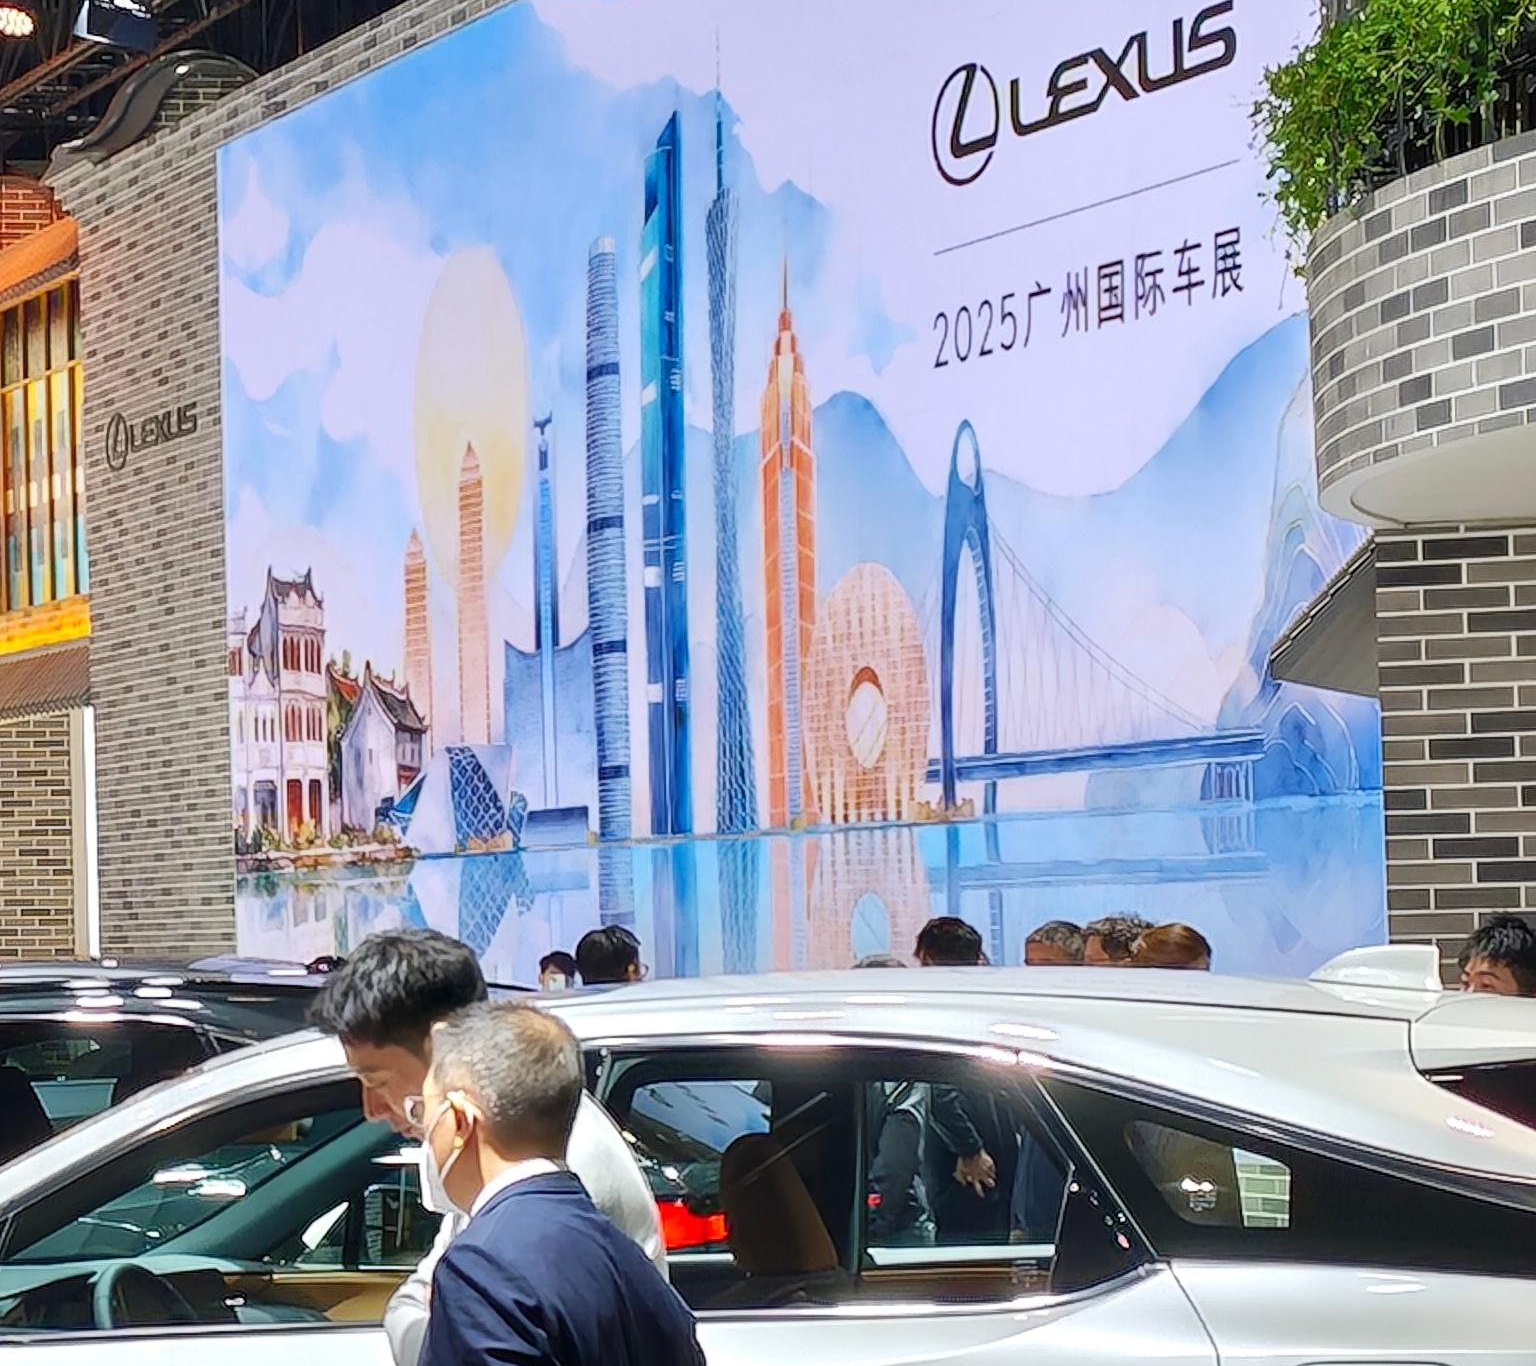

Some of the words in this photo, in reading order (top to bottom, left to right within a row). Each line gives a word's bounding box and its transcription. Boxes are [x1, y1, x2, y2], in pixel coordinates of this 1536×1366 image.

[933, 226, 1244, 369] 2025广州国际车展
[129, 401, 197, 453] LEXUS
